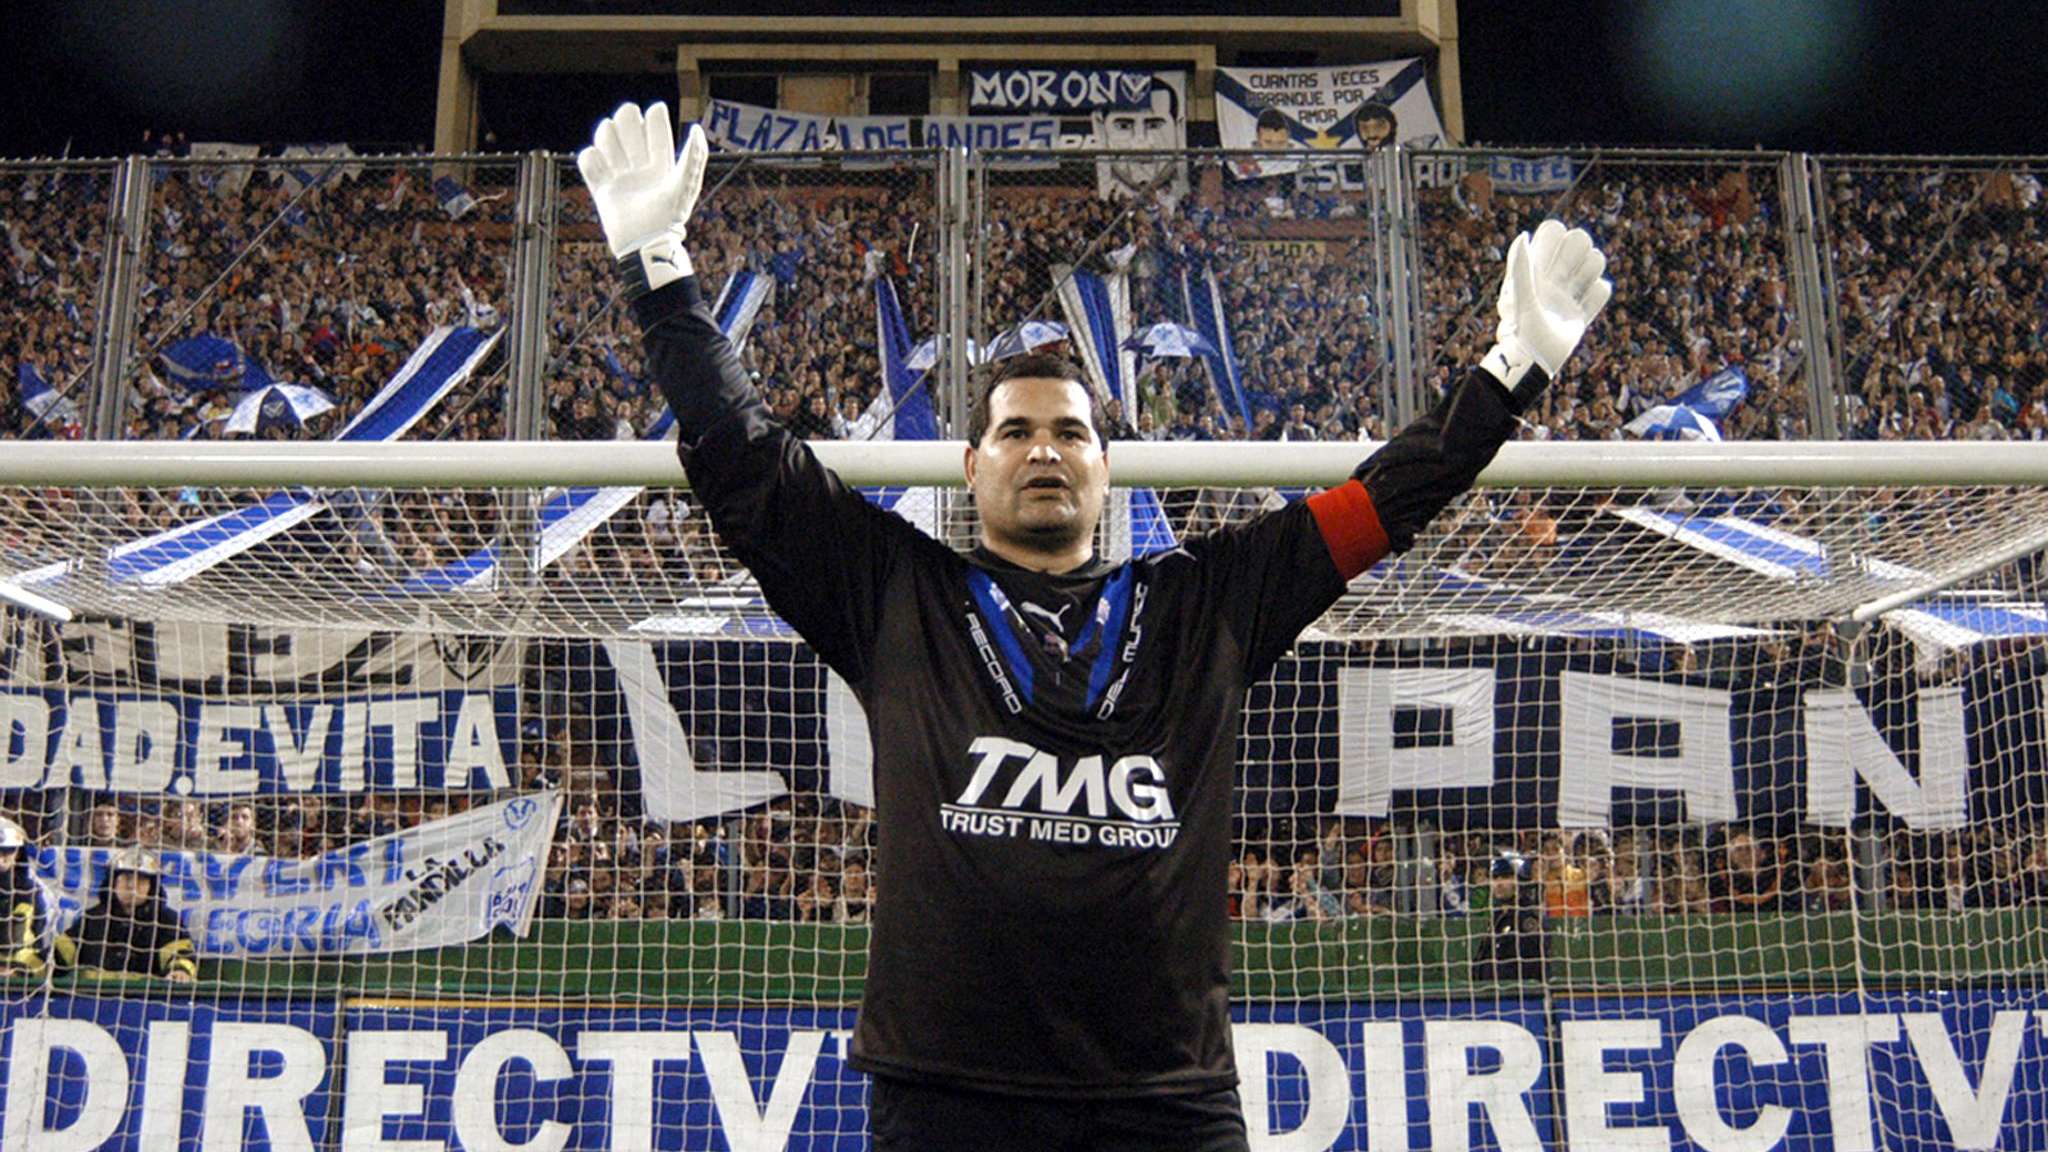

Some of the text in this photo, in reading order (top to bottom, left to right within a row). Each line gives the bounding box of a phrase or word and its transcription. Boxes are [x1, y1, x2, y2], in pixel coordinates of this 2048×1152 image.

[970, 70, 1122, 107] MORON
[1250, 69, 1379, 88] CUANTAS VECES
[1333, 88, 1364, 104] POR
[1298, 108, 1338, 124] AMOR
[965, 612, 1022, 715] RECORD
[957, 737, 1175, 821] TMG
[940, 809, 1023, 838] TRUST
[1030, 821, 1091, 847] MED
[4, 1017, 826, 1152] DIRECTV
[1234, 1011, 2028, 1152] DIRECTV
